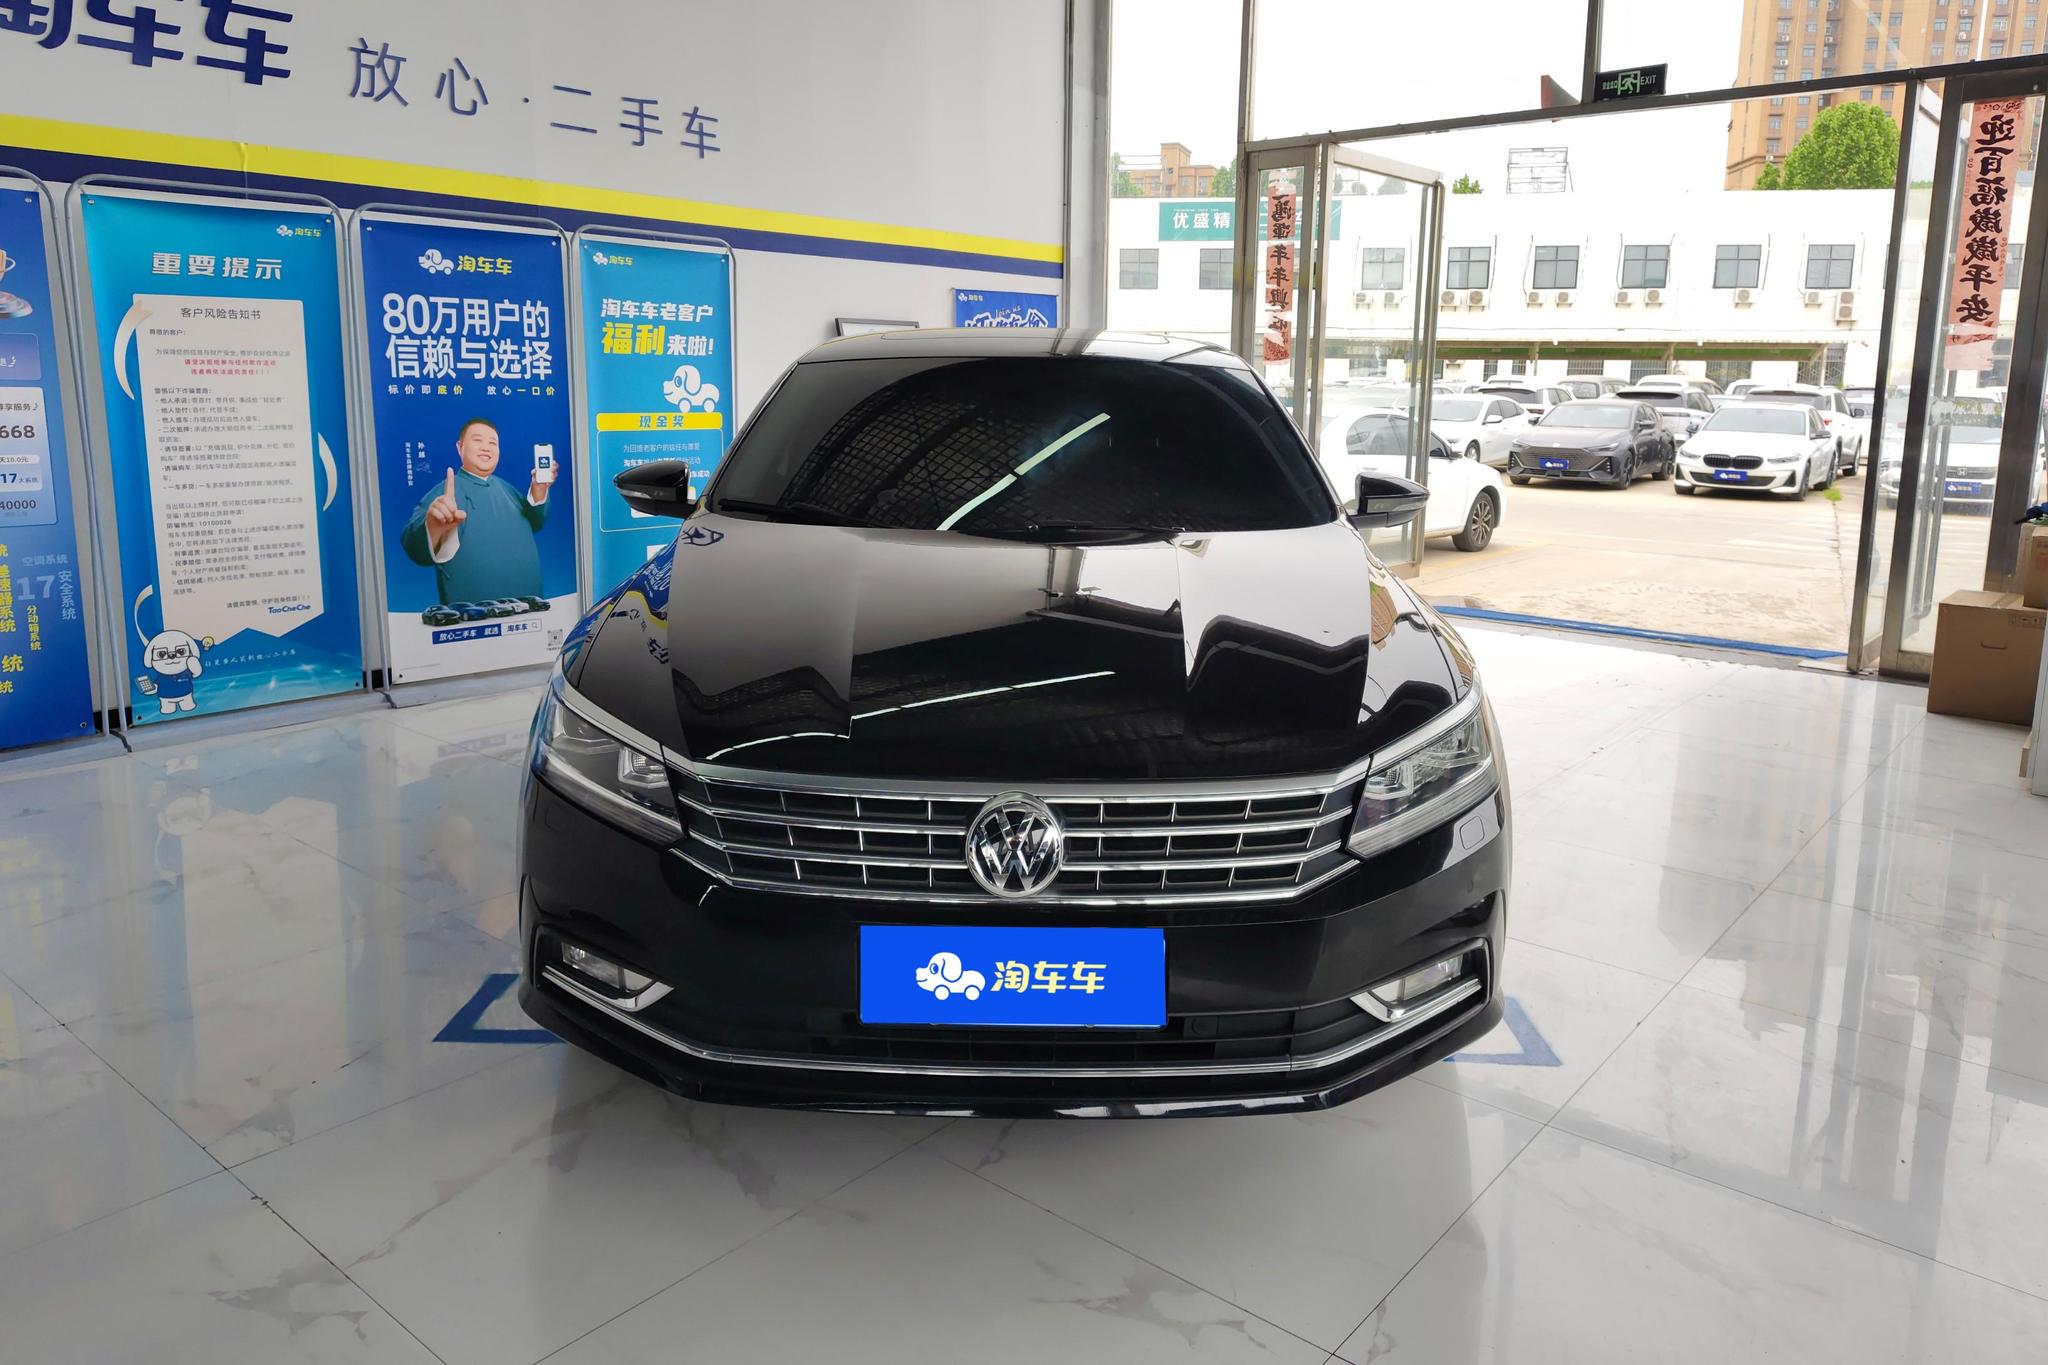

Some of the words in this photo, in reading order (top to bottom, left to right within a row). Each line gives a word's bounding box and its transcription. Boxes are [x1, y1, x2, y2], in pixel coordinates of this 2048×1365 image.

[1640, 74, 1657, 86] EXIT
[294, 227, 322, 238] 淘车车
[151, 252, 283, 280] 重要提示
[456, 254, 513, 275] 淘车车
[608, 255, 633, 266] 淘车车
[180, 307, 262, 320] 客户风险告知书
[381, 292, 550, 338] 80万用户的
[600, 298, 714, 322] 淘车车老客户
[385, 333, 553, 381] 信赖与选择
[388, 384, 464, 396] 标价即底价
[486, 385, 556, 396] 放心一口价
[639, 415, 685, 428] 现金奖
[22, 554, 69, 567] 空调系统
[17, 575, 56, 601] 17
[58, 570, 77, 621] 安全系统
[268, 604, 311, 615] TaoCheChe
[440, 629, 478, 641] 放心二手车
